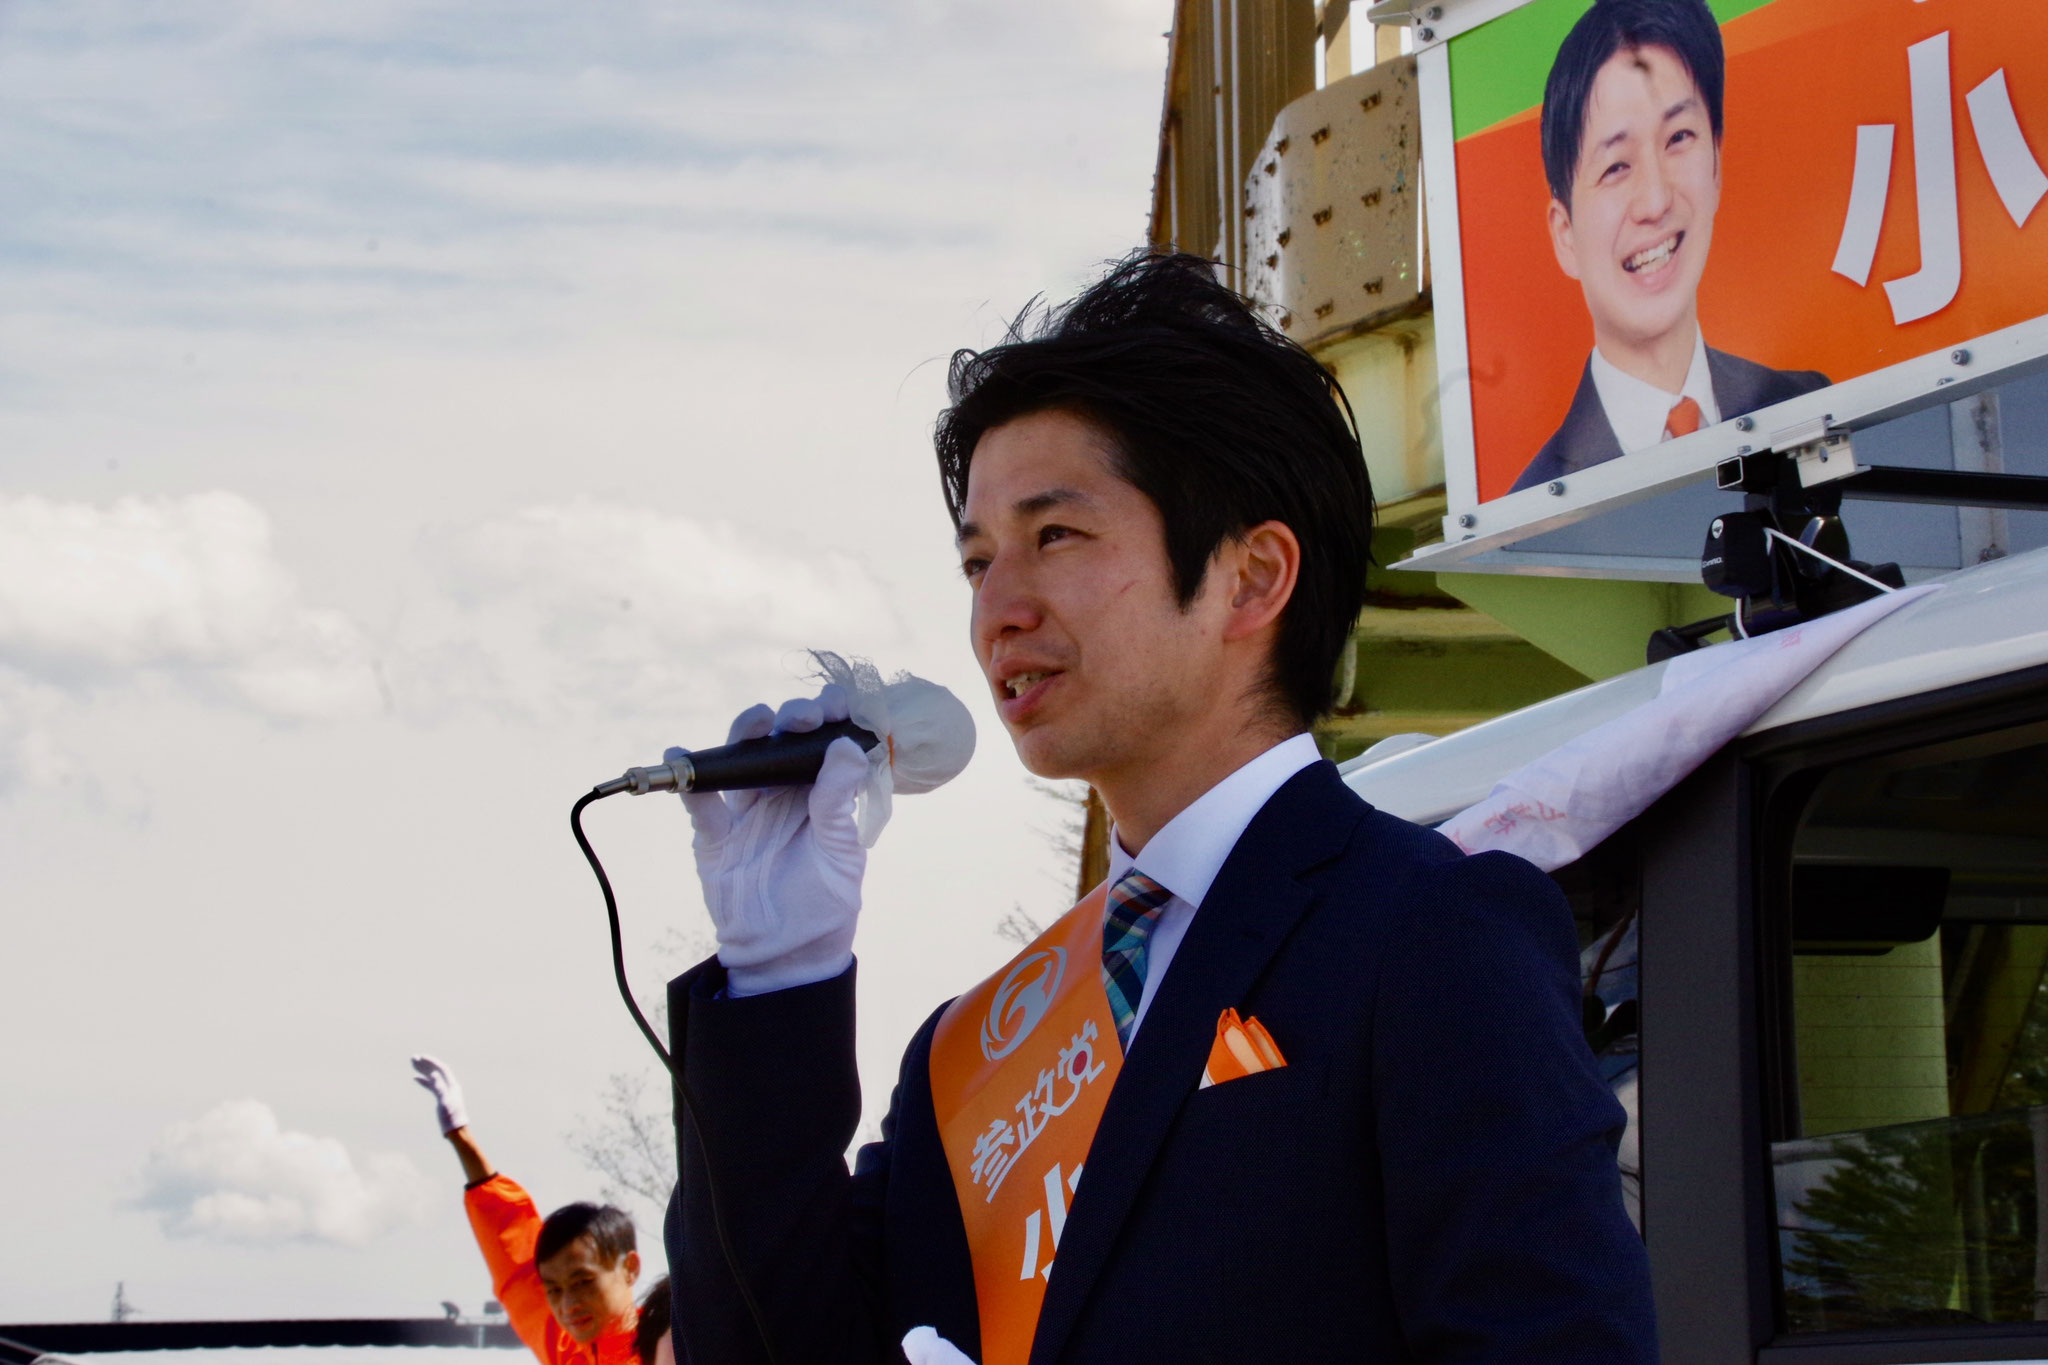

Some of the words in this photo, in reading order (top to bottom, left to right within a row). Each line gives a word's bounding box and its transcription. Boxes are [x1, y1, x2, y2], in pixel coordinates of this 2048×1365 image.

[1831, 30, 2048, 326] 小
[970, 1019, 1106, 1204] 参政党
